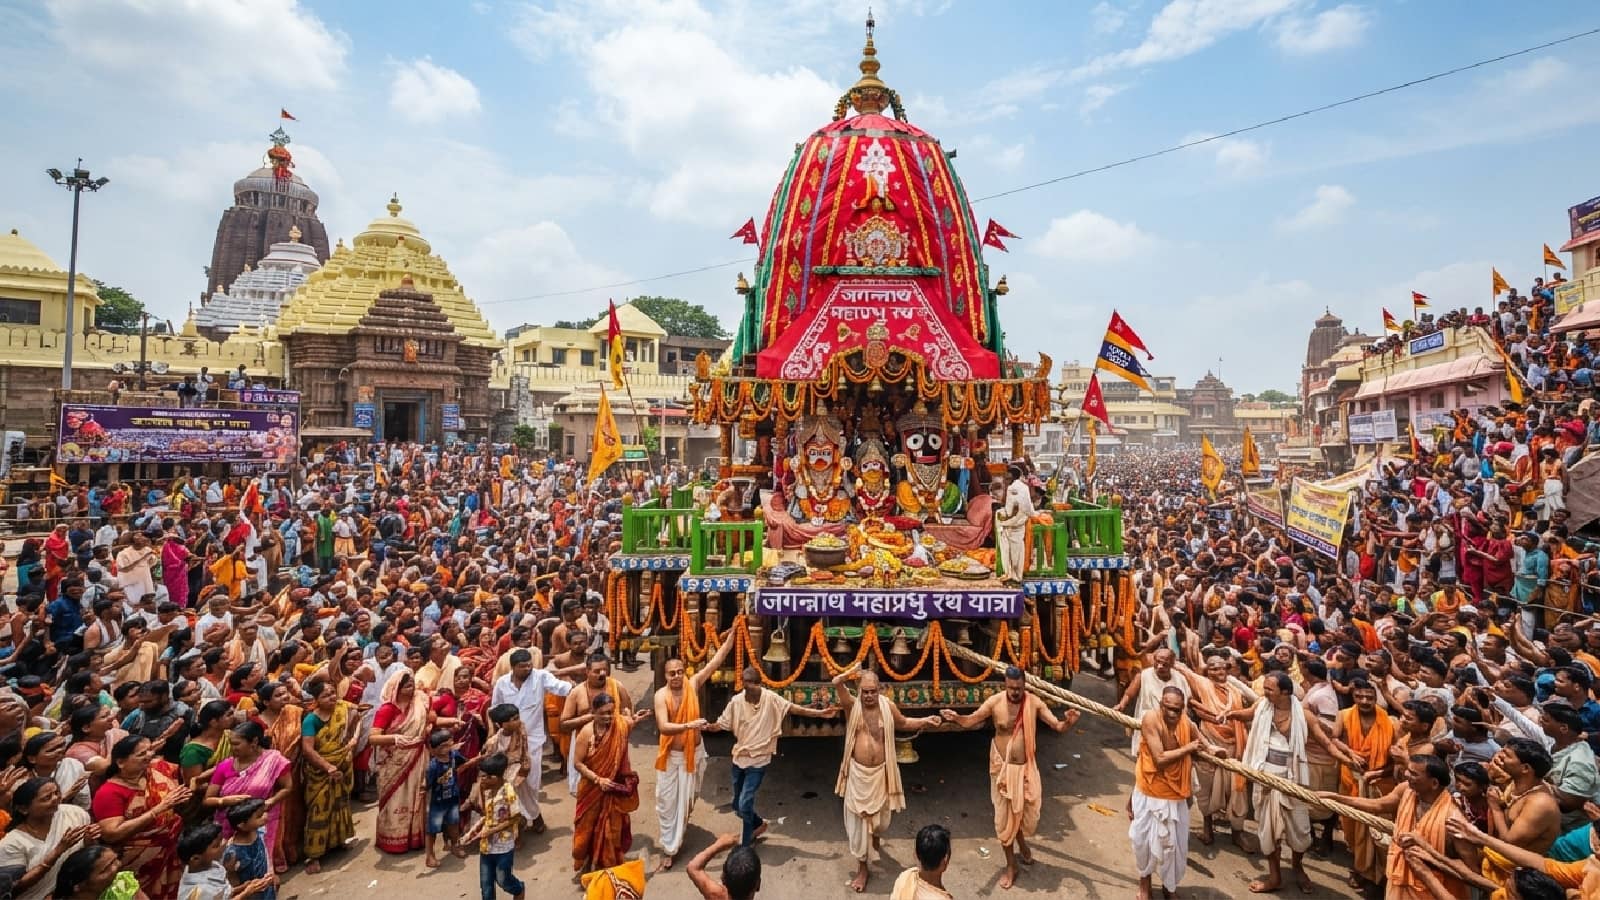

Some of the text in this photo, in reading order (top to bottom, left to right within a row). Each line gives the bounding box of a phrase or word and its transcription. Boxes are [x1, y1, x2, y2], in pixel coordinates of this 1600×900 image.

[851, 592, 928, 620] महाप्रभु
[932, 592, 964, 613] रथ
[967, 592, 1018, 614] यात्रा
